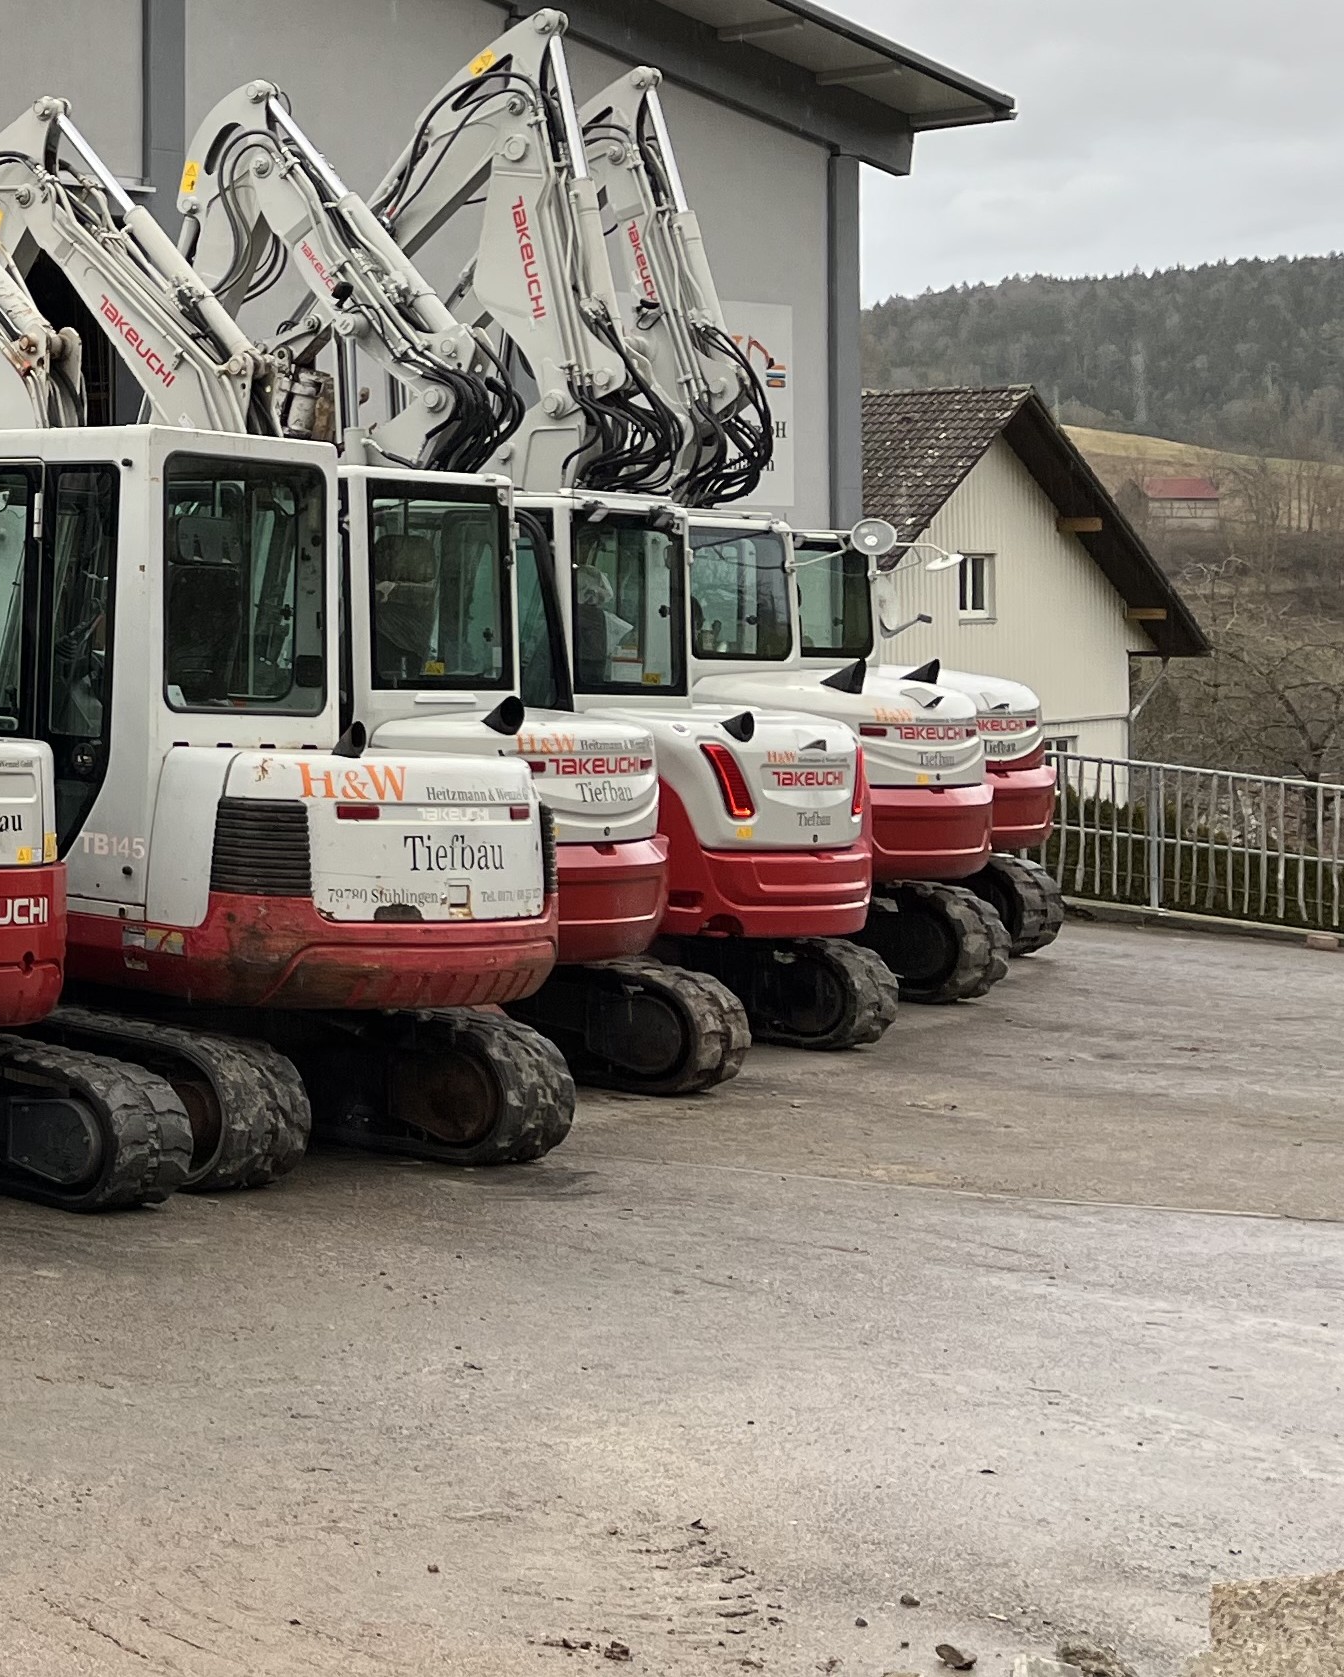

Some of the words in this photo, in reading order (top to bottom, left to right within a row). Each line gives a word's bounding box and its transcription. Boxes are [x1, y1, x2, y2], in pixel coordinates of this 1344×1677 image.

[627, 220, 660, 301] TAKEUCH
[516, 733, 575, 754] H&W
[295, 762, 407, 801] H&W
[426, 787, 487, 801] Heitzmann
[576, 780, 633, 803] Tiefbau
[79, 831, 146, 859] TB145
[404, 835, 504, 872] Tiefbau
